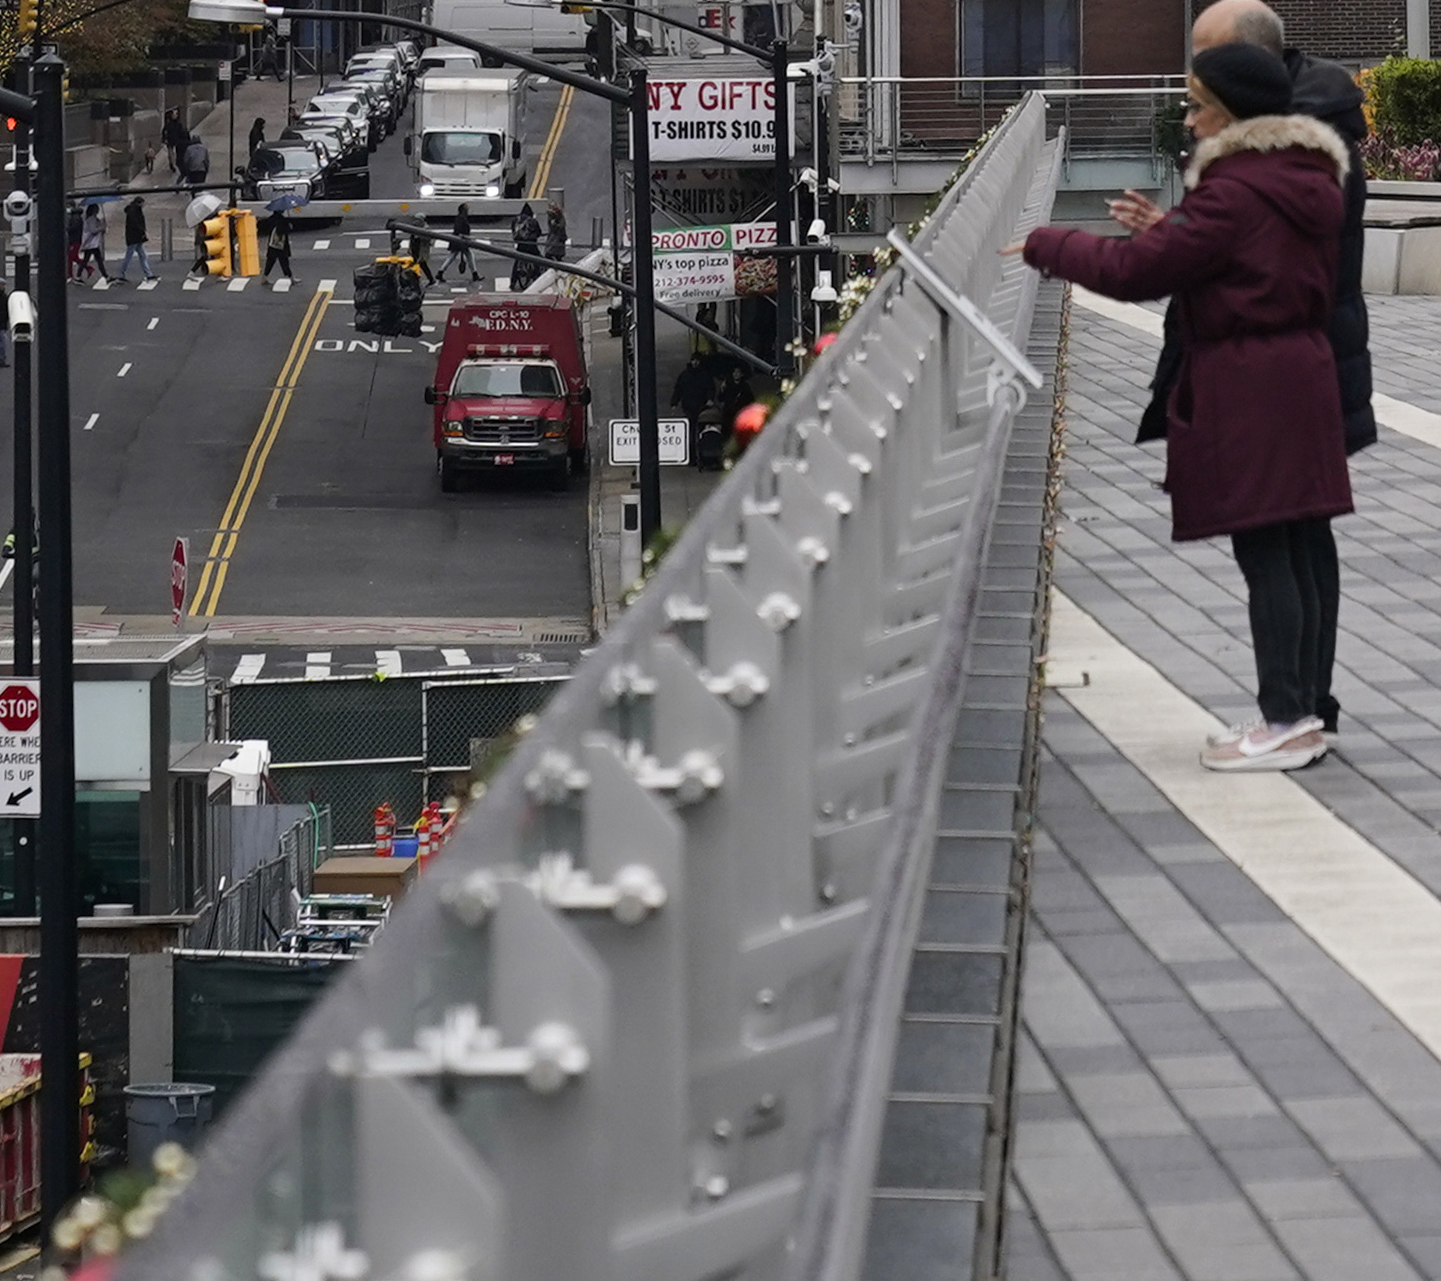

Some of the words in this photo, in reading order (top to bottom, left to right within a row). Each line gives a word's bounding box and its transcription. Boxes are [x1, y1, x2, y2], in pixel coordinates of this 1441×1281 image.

[647, 81, 687, 110] NY
[698, 81, 776, 110] GIFTS
[652, 120, 727, 139] T-SHIRTS
[731, 119, 776, 140] $10.9
[651, 230, 725, 250] PRONTO
[736, 227, 777, 245] PIZZ
[675, 258, 696, 273] top
[698, 255, 730, 272] pizza
[655, 273, 725, 287] 212-374-9595
[659, 290, 680, 300] Free
[682, 288, 721, 301] delivery
[314, 339, 444, 353] ONLY
[665, 424, 676, 433] St
[616, 437, 637, 446] EXIT
[20, 736, 41, 748] WHE
[3, 770, 15, 781] IS
[19, 770, 35, 781] UP
